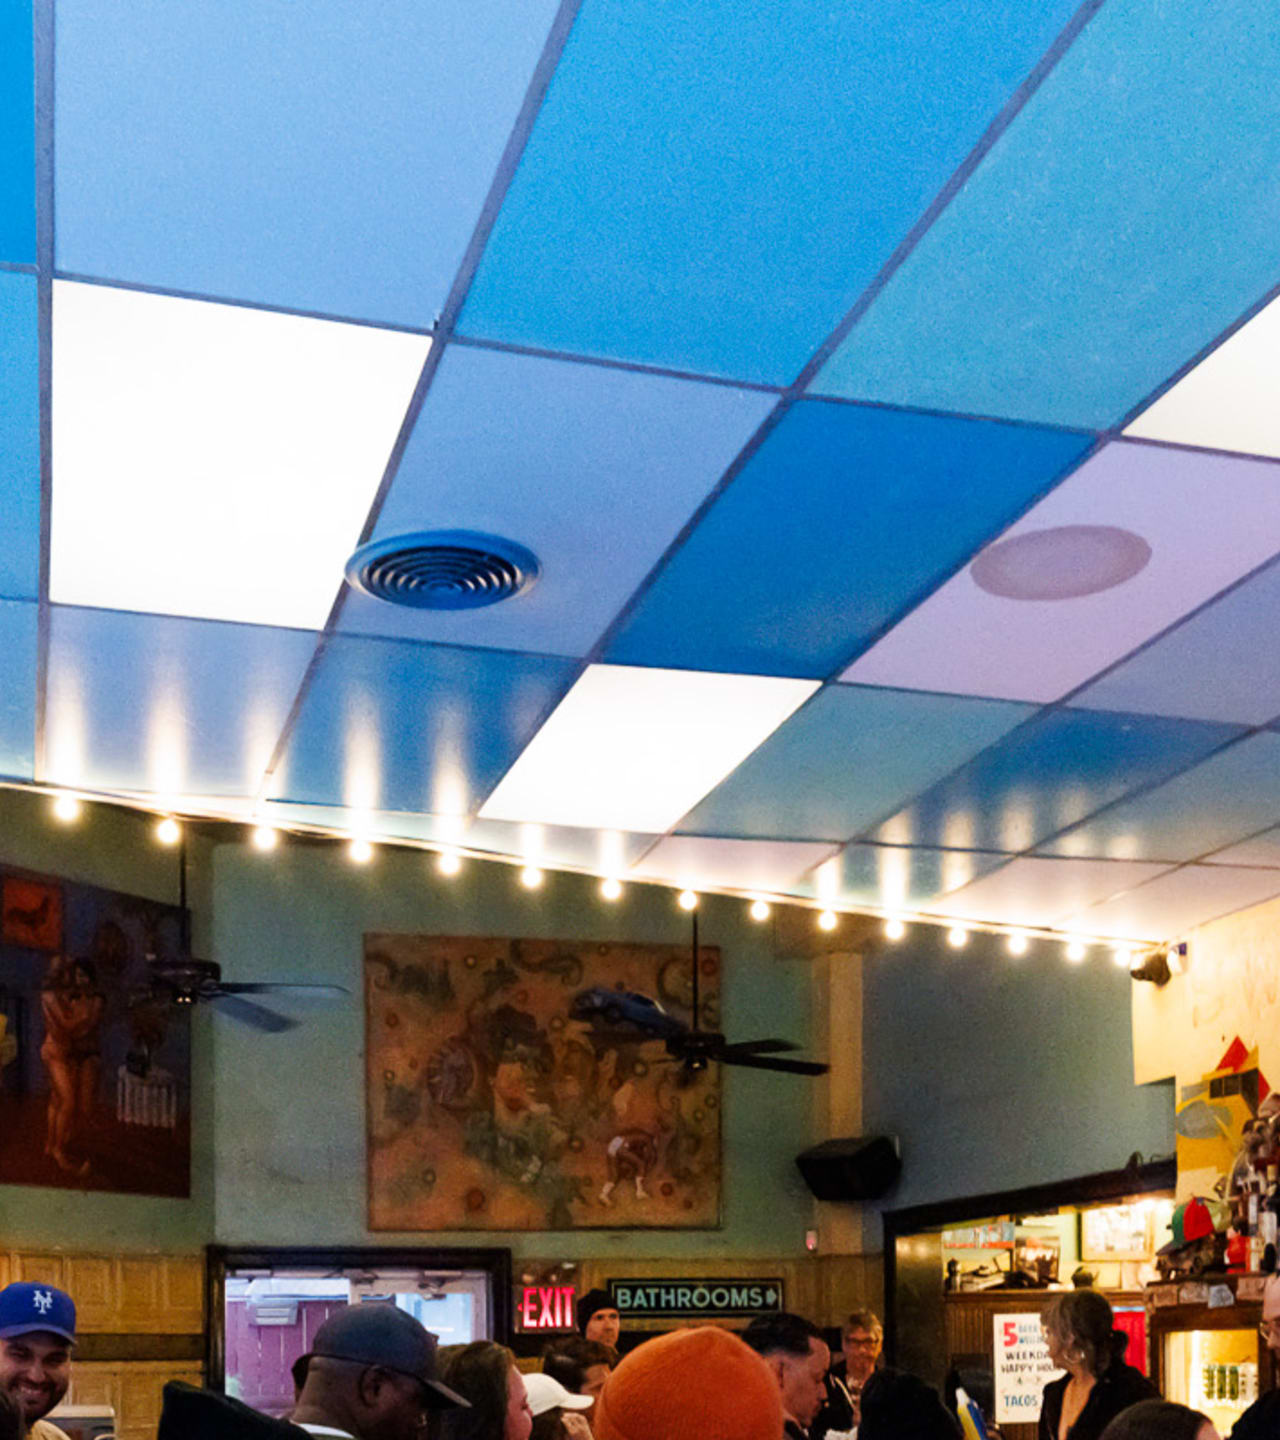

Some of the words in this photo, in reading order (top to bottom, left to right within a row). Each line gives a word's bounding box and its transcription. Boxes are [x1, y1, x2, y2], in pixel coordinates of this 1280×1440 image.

[523, 1287, 575, 1328] EXIT
[616, 1287, 763, 1308] BATHROOMS
[1003, 1322, 1018, 1347] 5
[1001, 1364, 1033, 1373] HAPPY
[1004, 1395, 1038, 1407] TACOS
